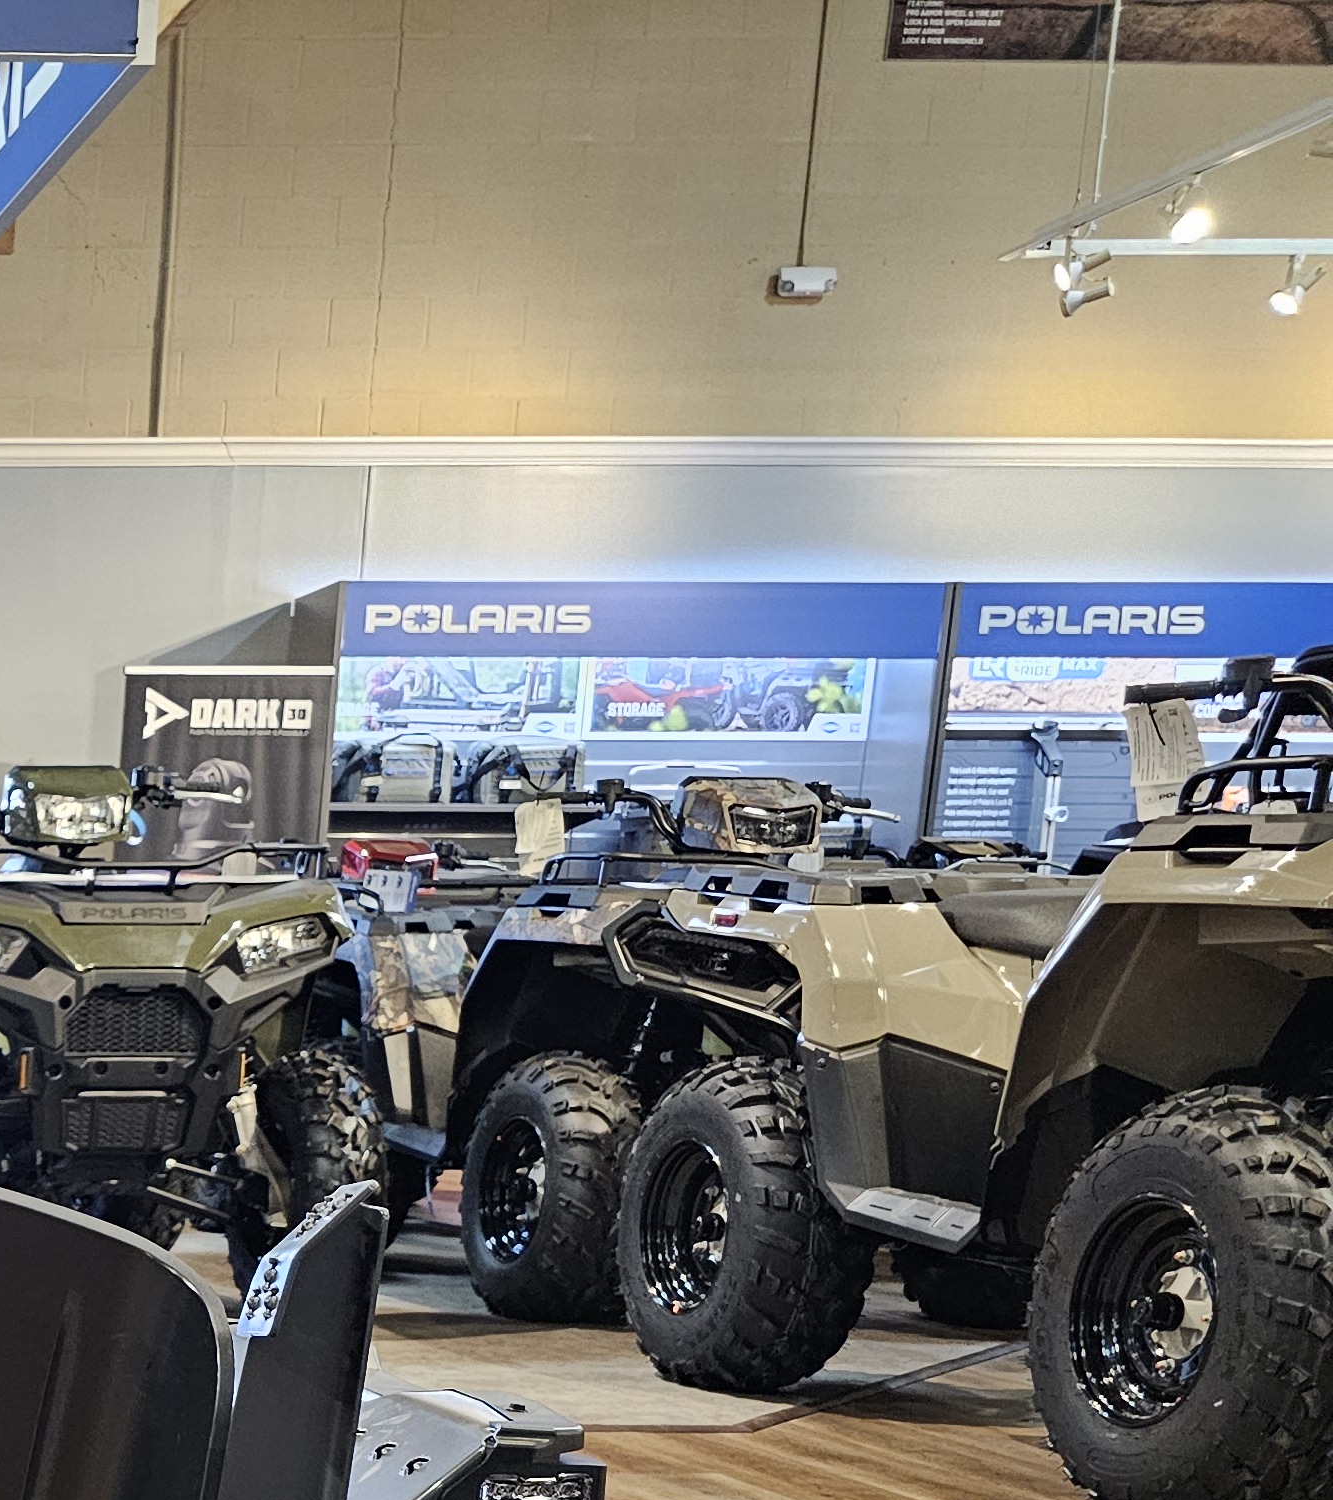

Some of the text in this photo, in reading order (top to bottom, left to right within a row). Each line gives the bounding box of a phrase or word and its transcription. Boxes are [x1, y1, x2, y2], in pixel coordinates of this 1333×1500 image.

[363, 604, 593, 635] POLARIS
[978, 606, 1207, 636] POLARIS
[1020, 665, 1053, 677] RIDE
[190, 698, 281, 729] DARK
[607, 702, 665, 717] STORAGE
[1158, 791, 1180, 801] POL
[80, 906, 188, 920] POLARIS
